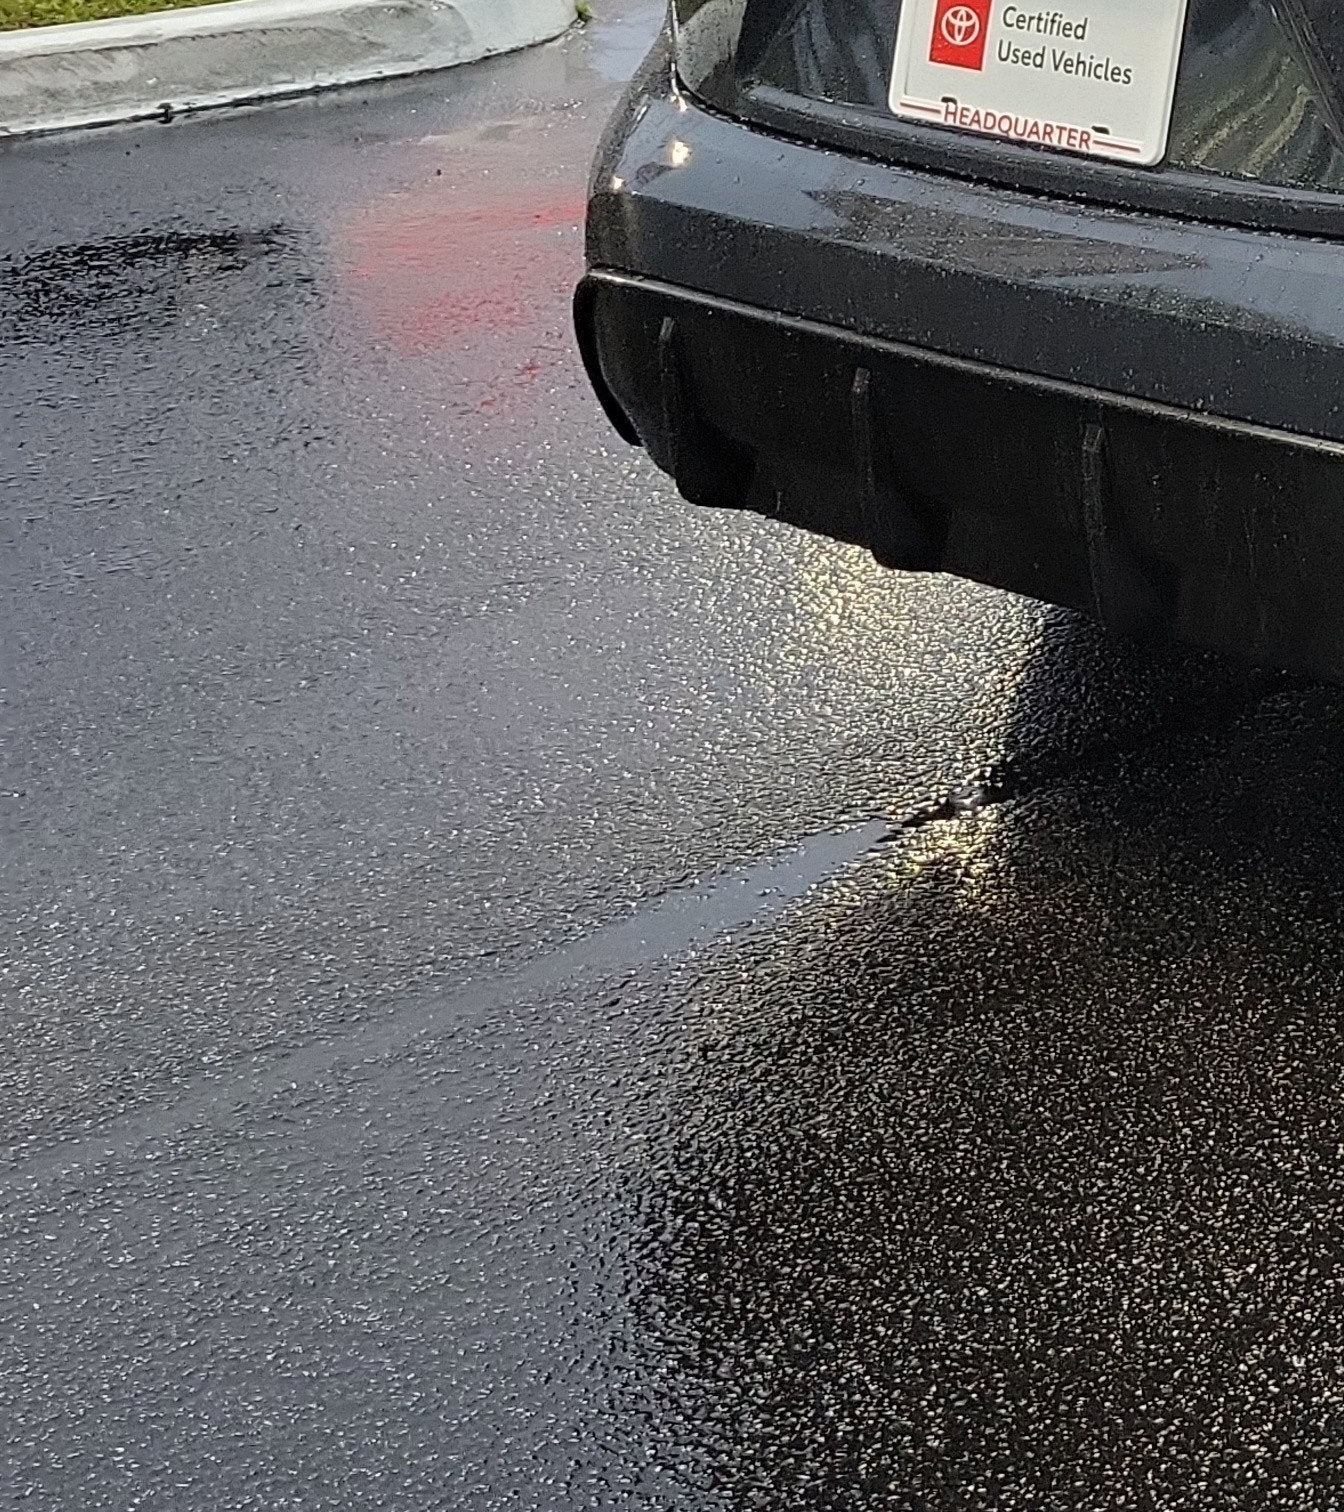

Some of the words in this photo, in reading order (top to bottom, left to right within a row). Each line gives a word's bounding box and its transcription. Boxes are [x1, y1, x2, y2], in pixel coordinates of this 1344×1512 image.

[1002, 5, 1088, 40] Certified
[998, 39, 1046, 68] Used
[1052, 48, 1132, 85] Vehicles
[943, 101, 1092, 150] HEADQUARTER
